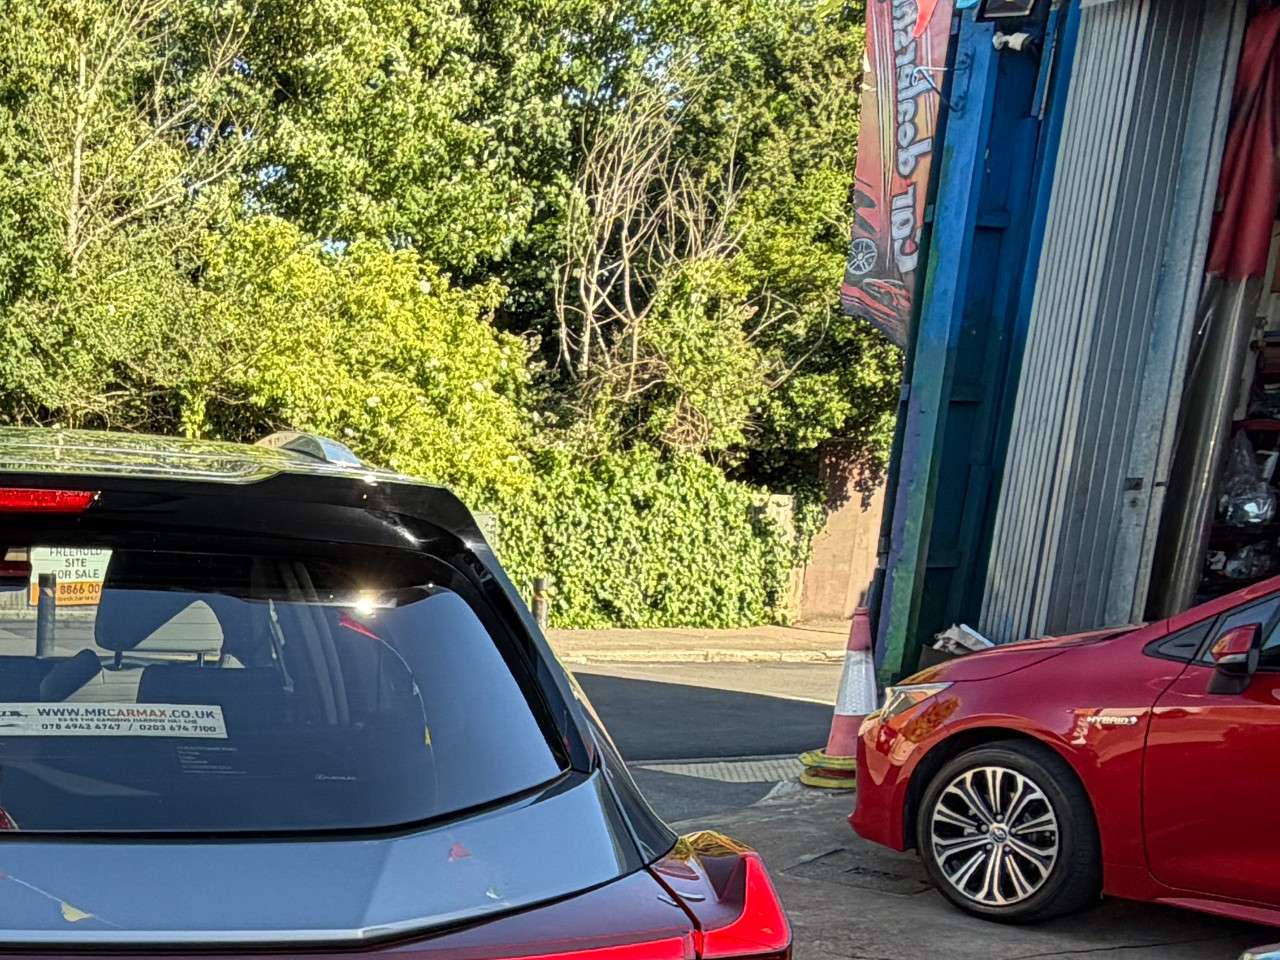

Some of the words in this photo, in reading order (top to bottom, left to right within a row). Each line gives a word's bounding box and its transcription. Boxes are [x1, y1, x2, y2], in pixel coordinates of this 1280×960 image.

[65, 558, 87, 567] SITE
[75, 569, 100, 579] SALE
[60, 584, 85, 595] 8866
[37, 708, 216, 719] WWW.MRCARMAX.CO.UK
[1087, 716, 1129, 725] HYBRID
[128, 723, 133, 731] /
[191, 725, 216, 733] 7100
